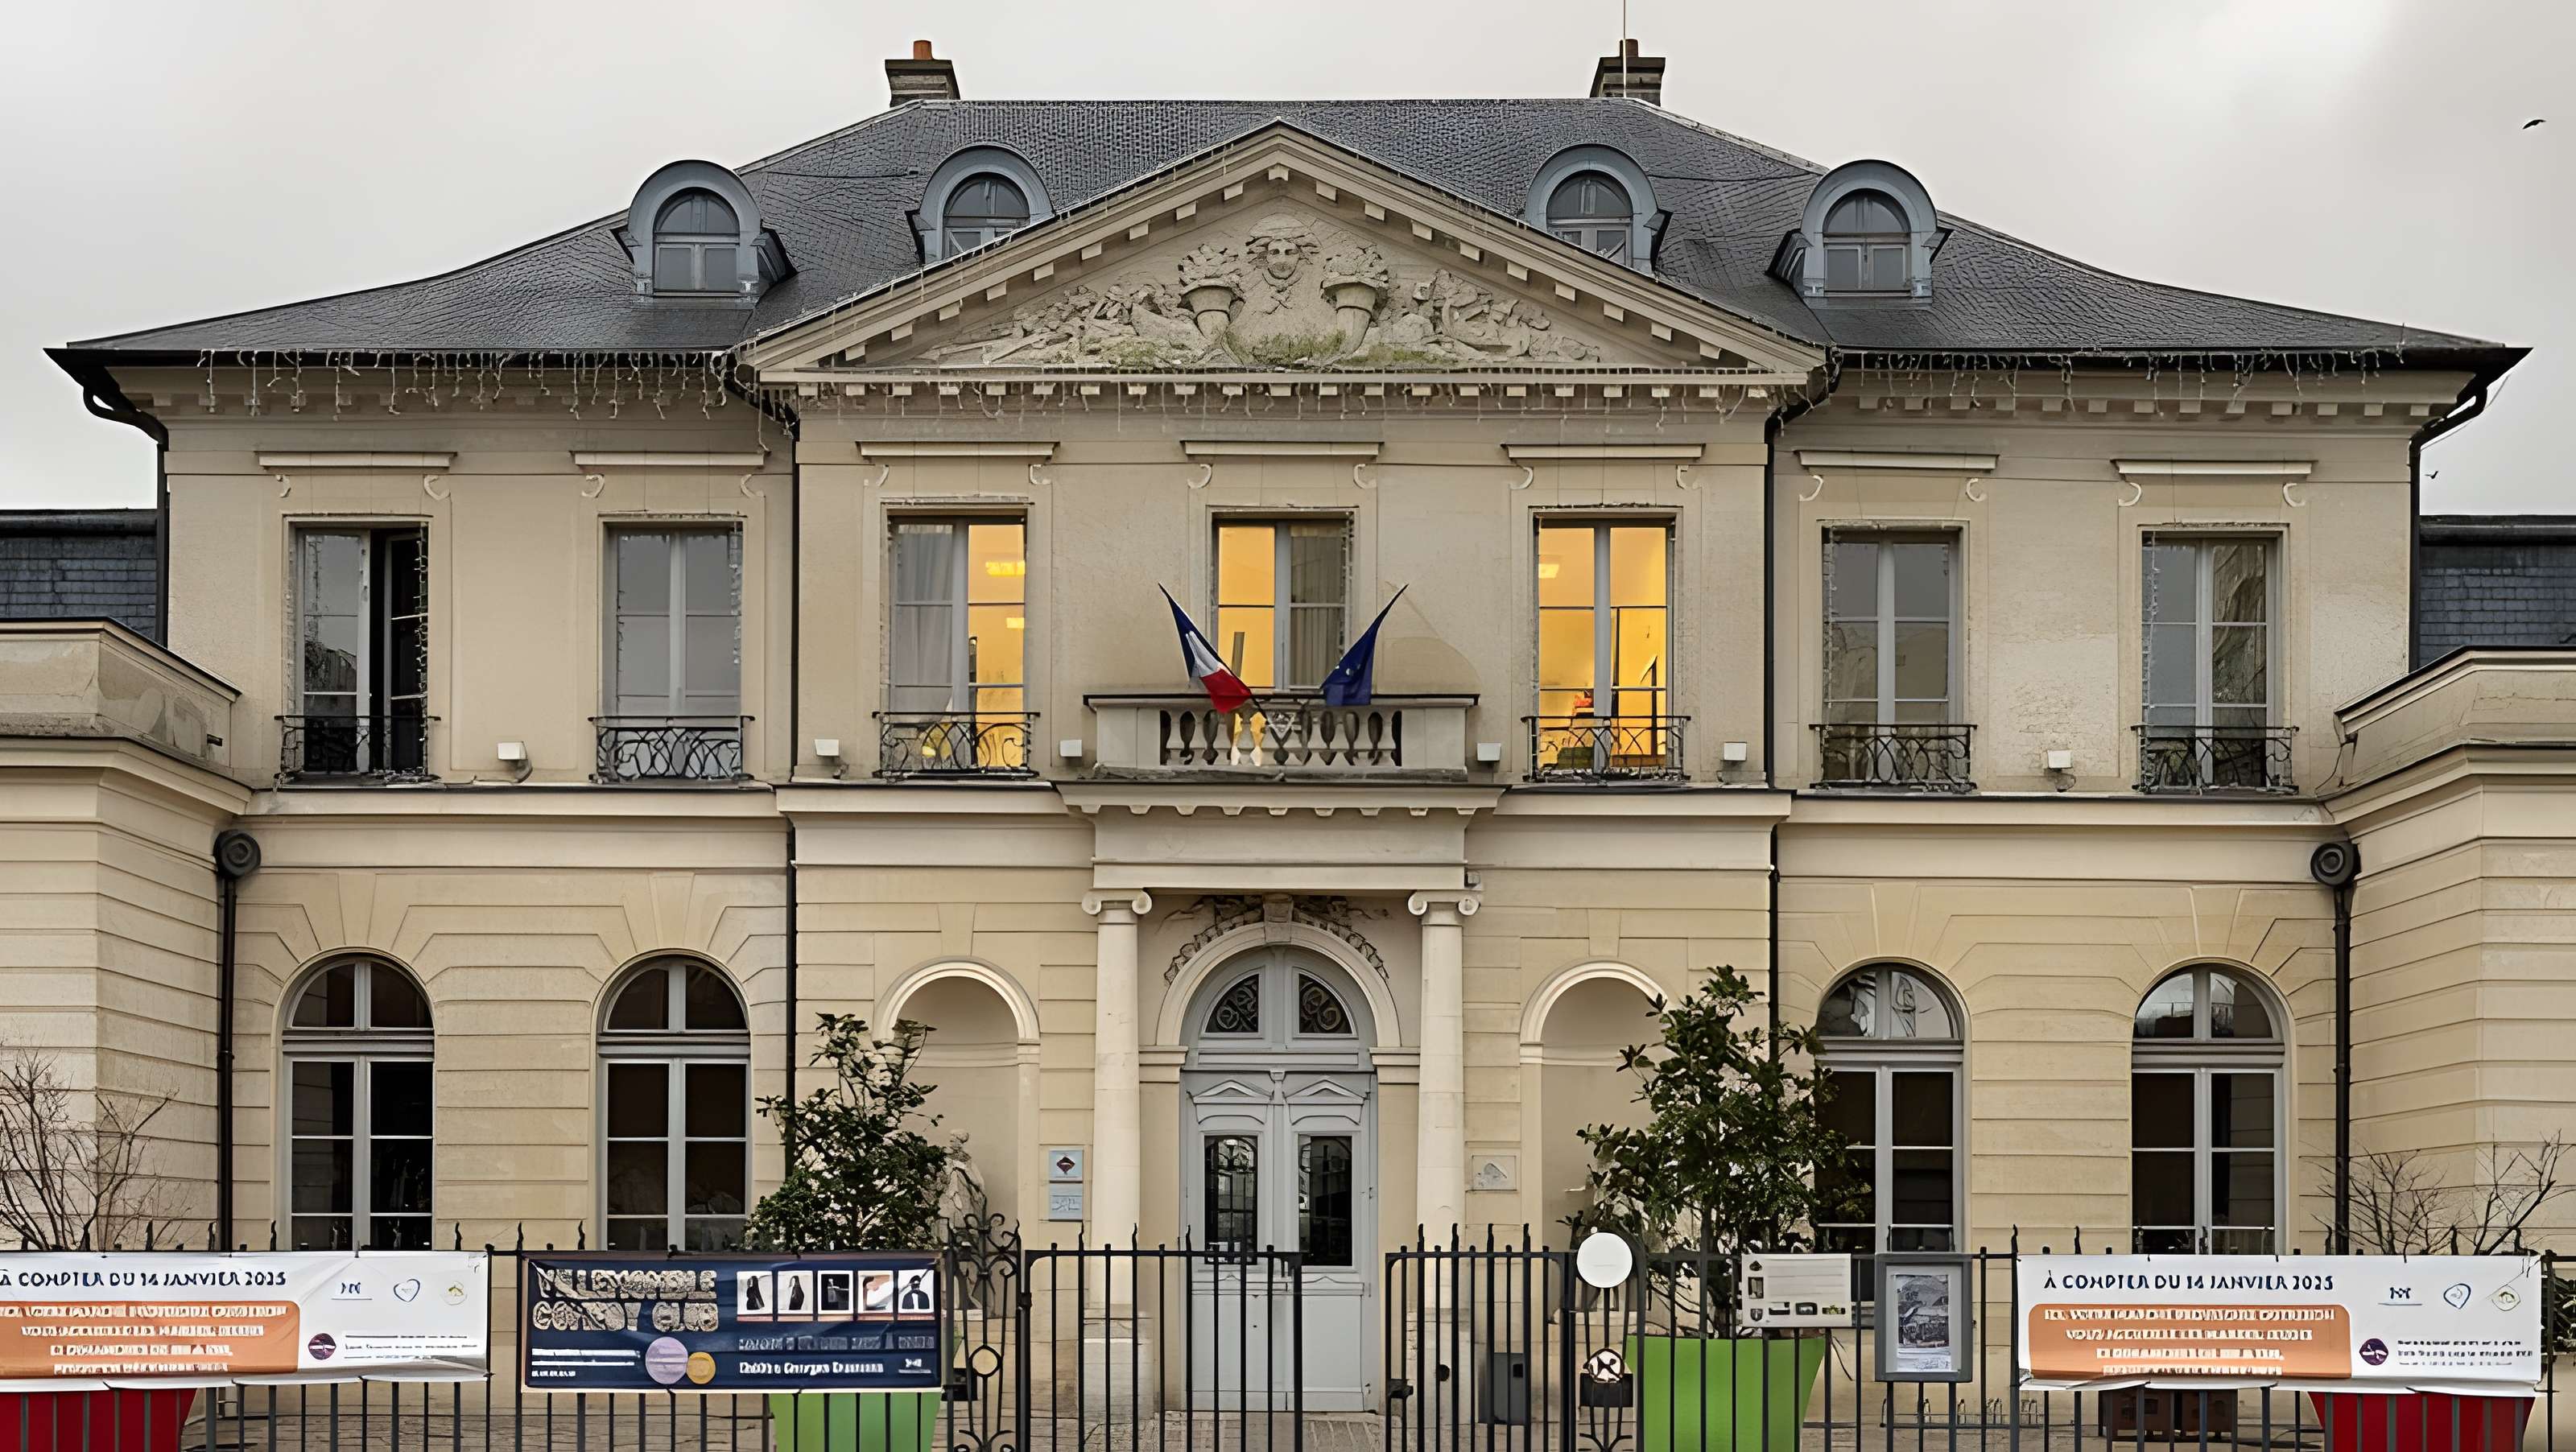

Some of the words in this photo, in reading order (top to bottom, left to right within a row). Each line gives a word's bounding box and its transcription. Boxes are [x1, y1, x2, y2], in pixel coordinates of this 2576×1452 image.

[110, 1273, 134, 1286] DU
[163, 1272, 240, 1287] JANVIER
[2044, 1269, 2057, 1289] À
[2155, 1275, 2180, 1289] DU
[2210, 1275, 2287, 1290] JANVIER
